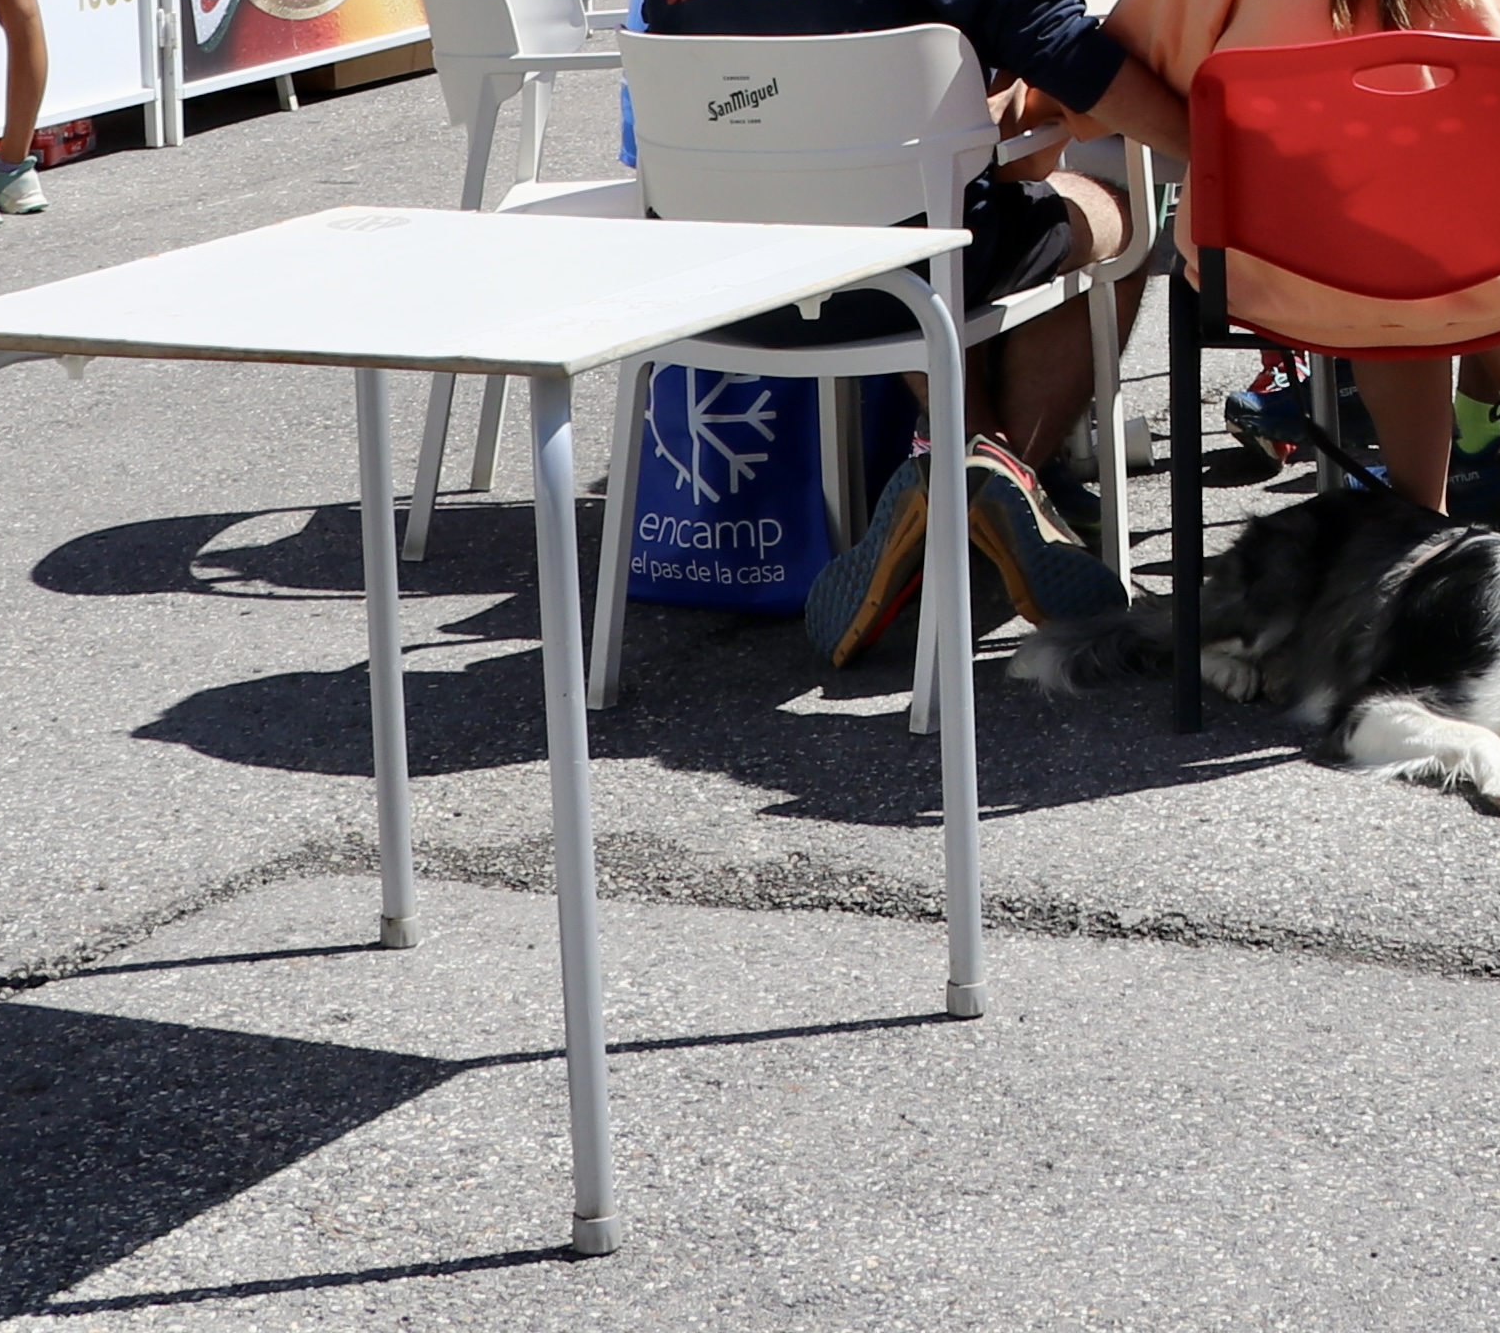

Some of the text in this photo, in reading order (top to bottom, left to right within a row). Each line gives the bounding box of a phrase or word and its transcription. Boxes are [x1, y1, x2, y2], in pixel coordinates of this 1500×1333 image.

[639, 512, 783, 560] encamp
[631, 551, 785, 584] el pas de la casa
